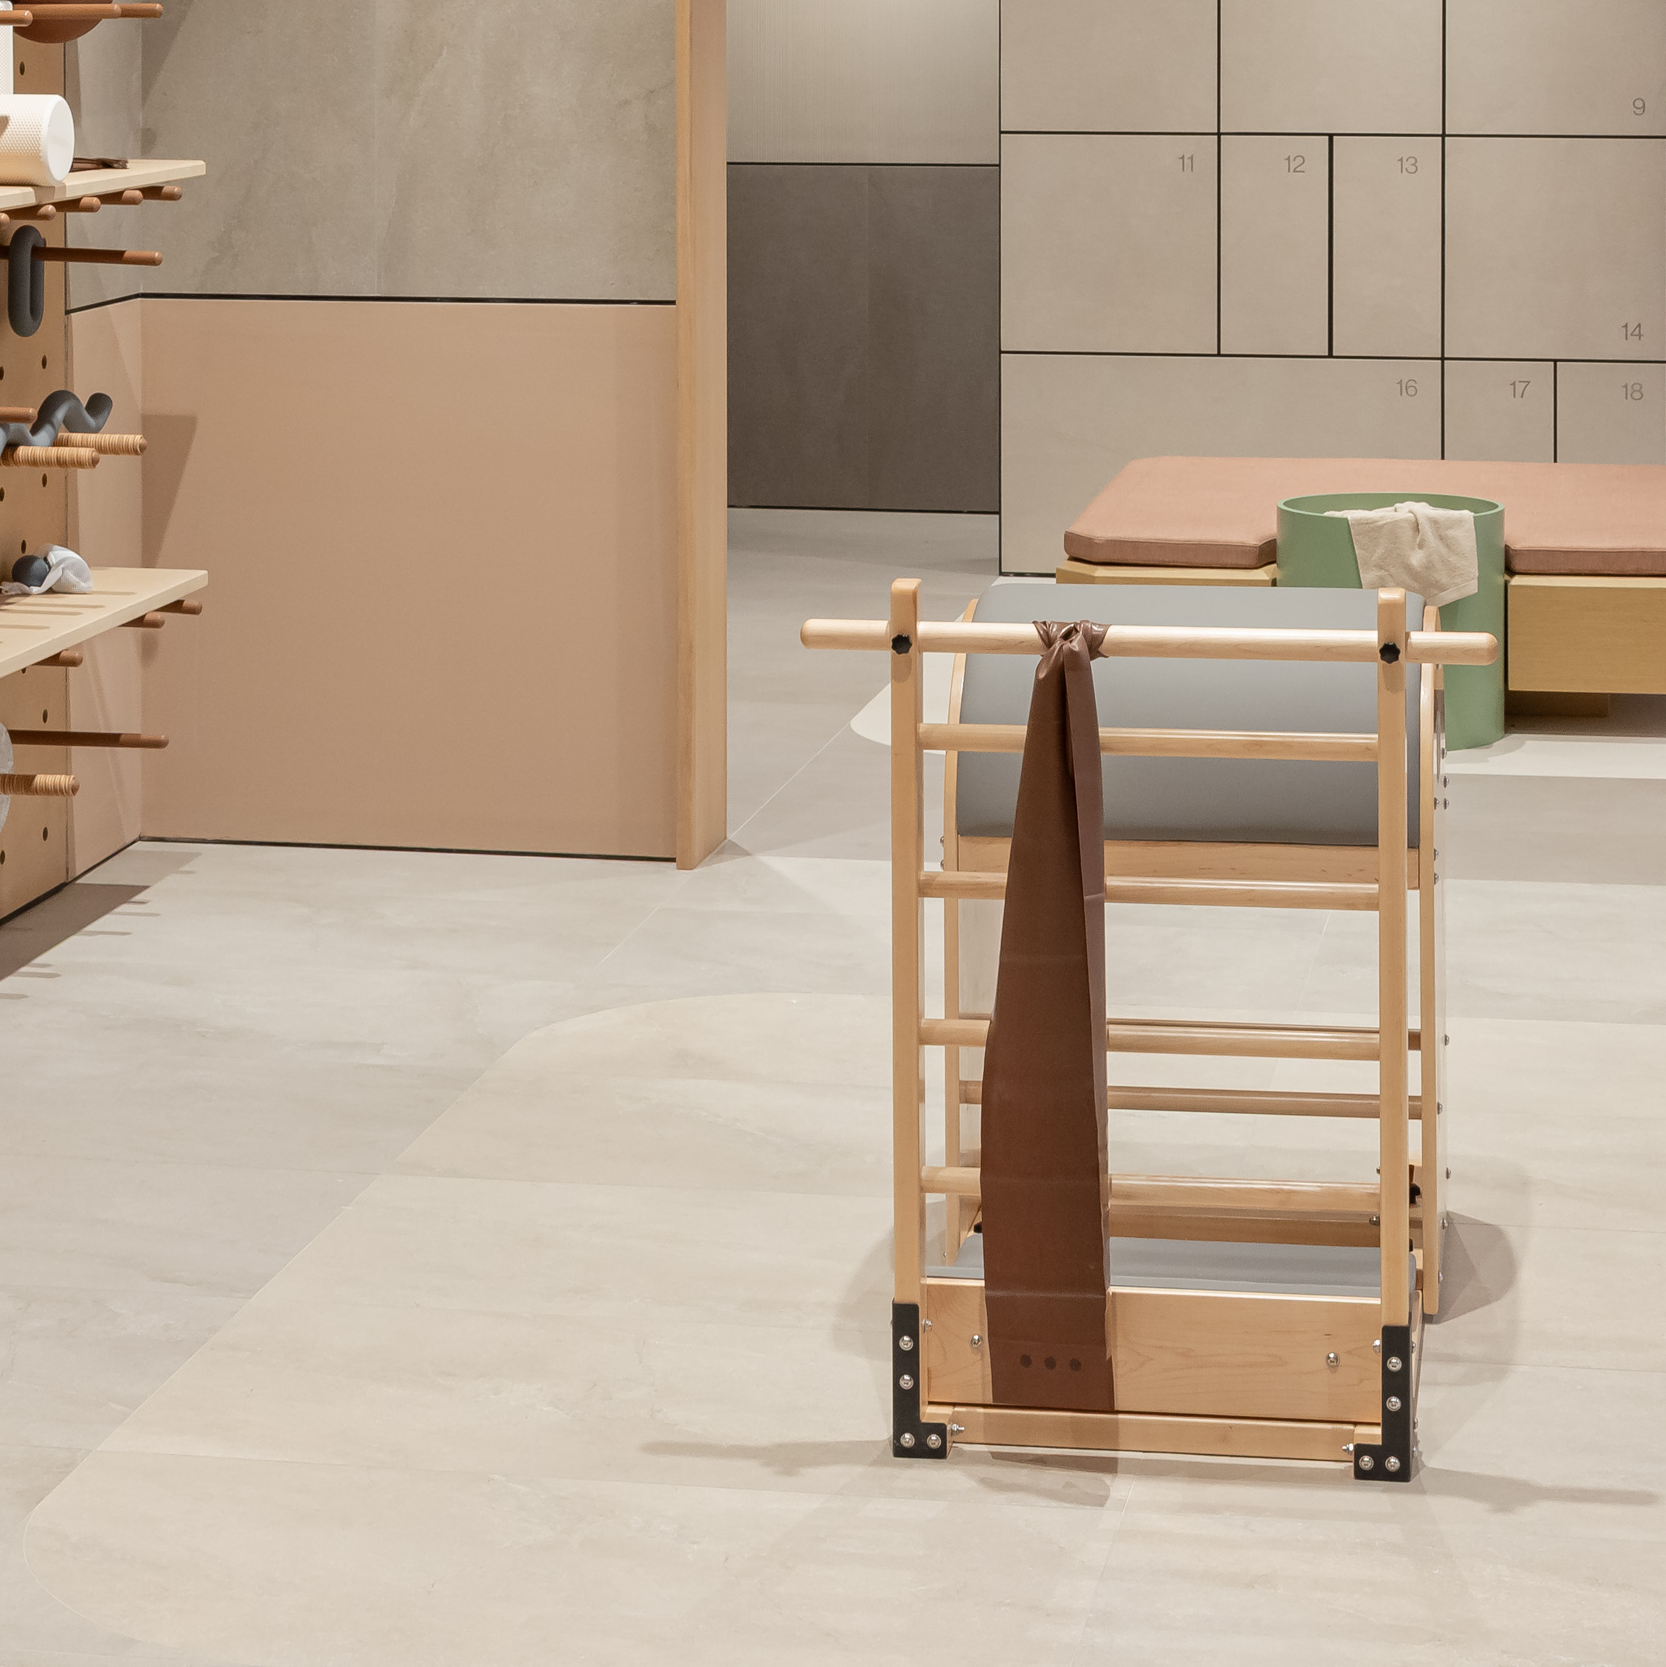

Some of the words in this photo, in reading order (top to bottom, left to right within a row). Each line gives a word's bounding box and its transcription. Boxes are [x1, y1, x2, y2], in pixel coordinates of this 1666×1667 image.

[1632, 97, 1646, 116] 9
[1178, 154, 1194, 173] 11
[1283, 155, 1306, 173] 12
[1396, 155, 1419, 174] 13
[1621, 322, 1644, 341] 14
[1396, 378, 1418, 397] 16
[1509, 380, 1531, 399] 17
[1621, 382, 1644, 401] 18
